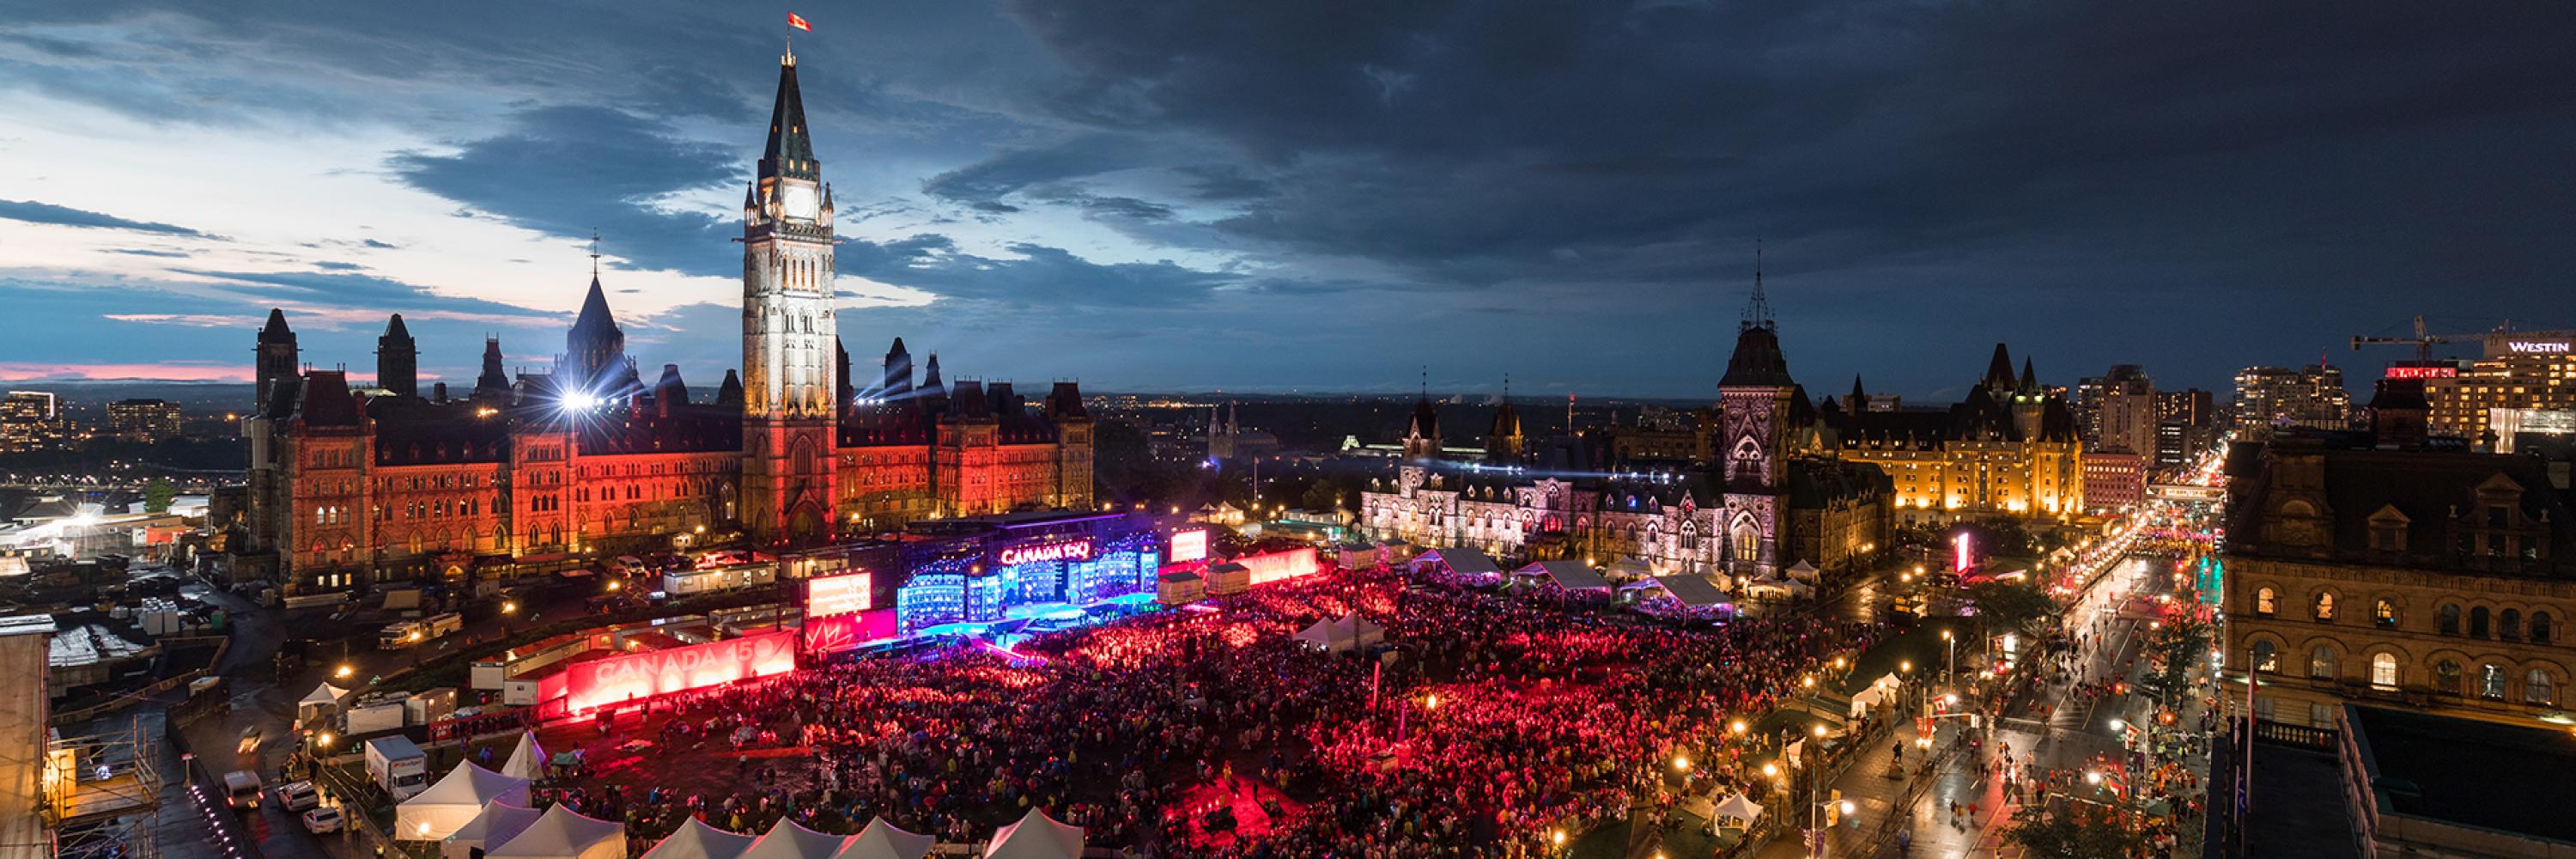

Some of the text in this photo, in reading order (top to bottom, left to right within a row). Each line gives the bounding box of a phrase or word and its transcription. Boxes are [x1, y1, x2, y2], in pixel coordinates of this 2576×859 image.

[2508, 342, 2569, 352] WESTIN
[1001, 541, 1089, 565] CANADA 150
[595, 638, 773, 685] CANADA 150
